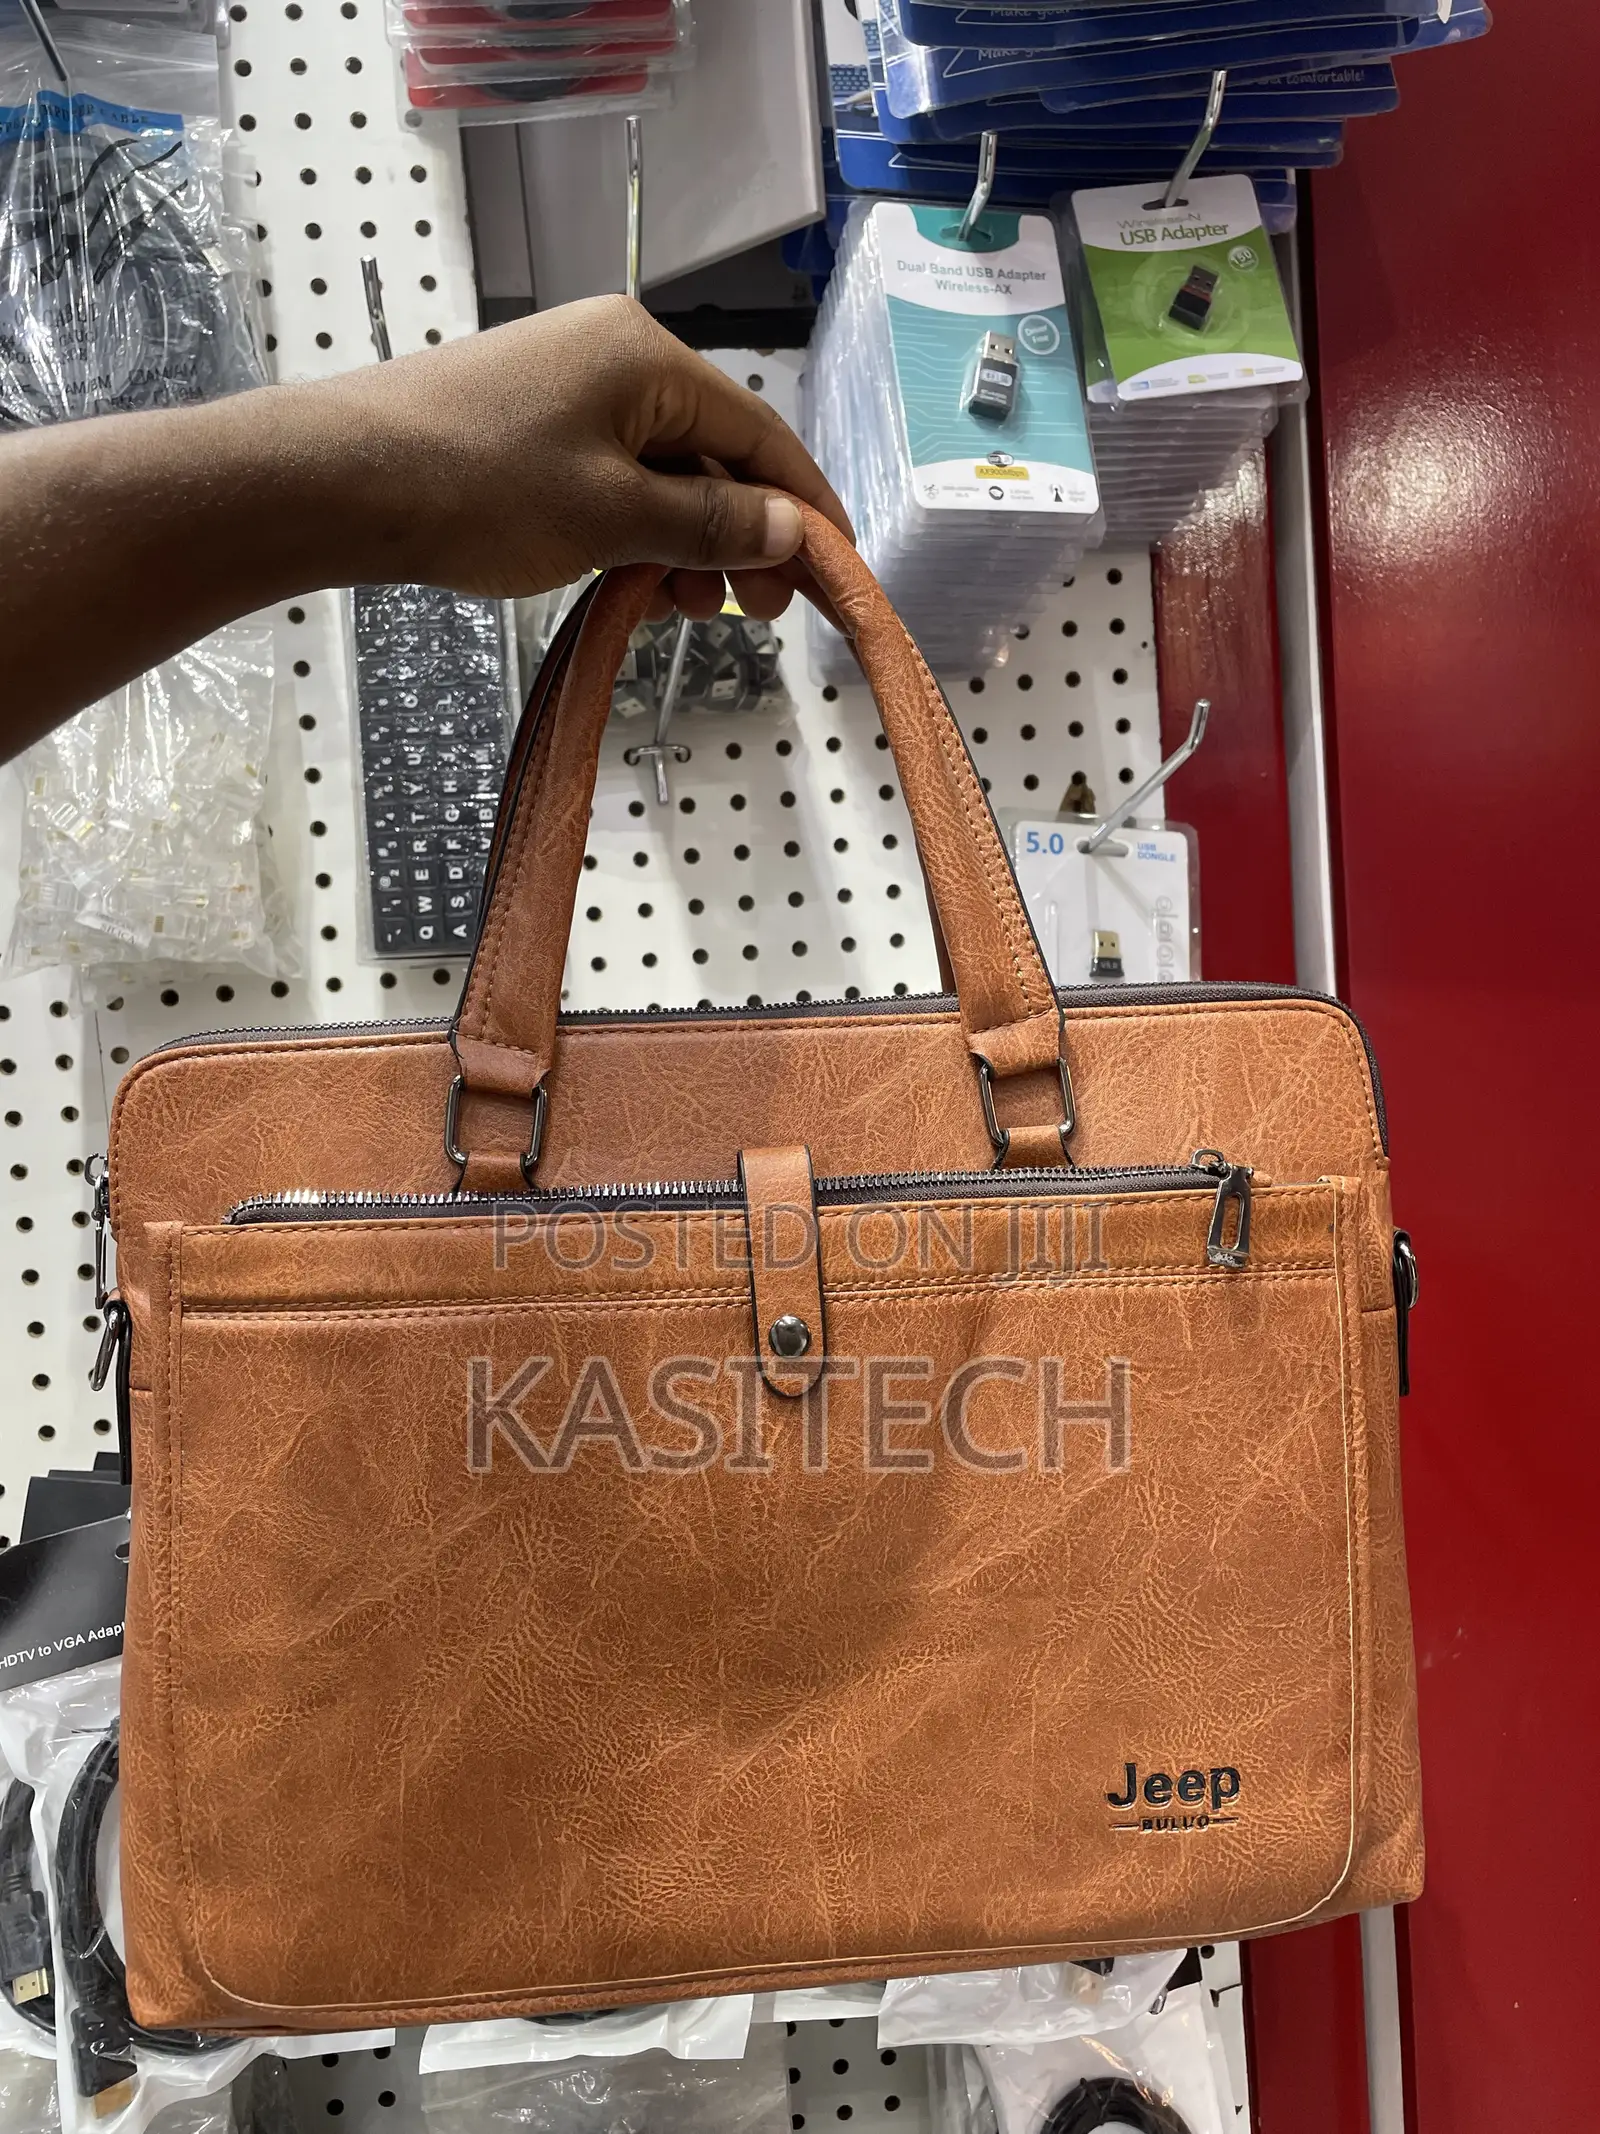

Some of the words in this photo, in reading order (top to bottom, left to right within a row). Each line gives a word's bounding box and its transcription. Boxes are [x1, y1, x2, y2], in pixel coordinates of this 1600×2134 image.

[1120, 229, 1157, 246] USB
[1161, 224, 1229, 241] Adapter
[897, 260, 926, 273] Dual
[930, 263, 963, 276] Band
[966, 266, 994, 279] USB
[997, 269, 1047, 282] Adapter
[936, 279, 1013, 295] Wireless-AX
[1026, 831, 1064, 854] 5.0
[1137, 842, 1157, 851] USB
[1137, 851, 1177, 862] DONGLE
[0, 1648, 36, 1670] HDTV
[38, 1646, 52, 1657] to
[53, 1633, 86, 1652] VGA
[1106, 1762, 1241, 1810] Jeep
